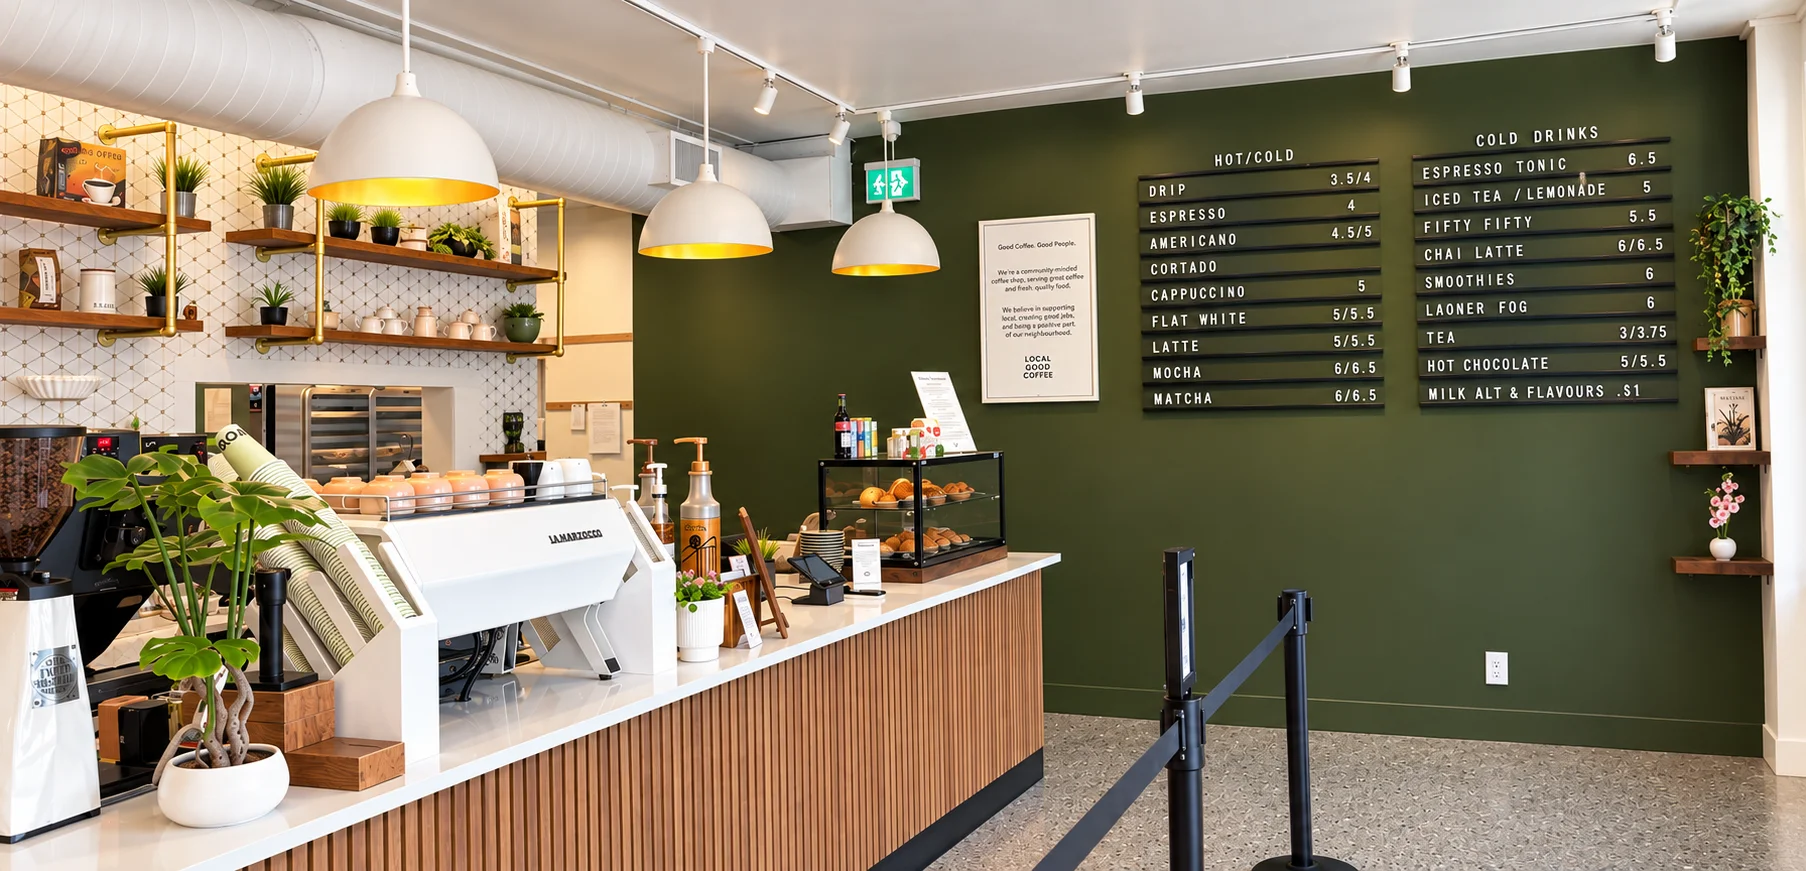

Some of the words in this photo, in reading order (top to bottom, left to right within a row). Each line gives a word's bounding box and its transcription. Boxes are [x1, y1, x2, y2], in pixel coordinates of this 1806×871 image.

[1476, 131, 1518, 148] COLD
[1534, 125, 1598, 144] DRINKS
[1214, 148, 1294, 167] HOT/COLD
[1628, 151, 1656, 166] 6.5
[1422, 161, 1502, 180] ESPRESSO
[1515, 157, 1566, 173] TONIC
[1330, 171, 1371, 186] 3.5/4
[1149, 183, 1186, 198] DRIP
[1643, 180, 1651, 194] 5
[1347, 199, 1356, 212] 4
[1424, 192, 1461, 207] ICED
[1472, 189, 1502, 204] TEA
[1149, 207, 1226, 224] ESPRESSO
[1629, 208, 1657, 223] 5.5
[1331, 225, 1372, 239] 4.5/5
[1424, 218, 1471, 234] FIFTY
[1484, 215, 1532, 231] FIFTY
[997, 243, 1014, 251] Good
[1054, 240, 1076, 248] People.
[1149, 233, 1237, 250] AMERICANO
[1618, 237, 1663, 252] 6/6.5
[1424, 247, 1461, 262] CHAI
[1475, 244, 1524, 259] LATTE
[1150, 260, 1217, 276] CORTADO
[1645, 266, 1654, 280] 6
[1027, 275, 1048, 283] serving
[1358, 279, 1366, 293] 5
[1425, 272, 1515, 289] SMOOTHIES
[1151, 285, 1245, 302] CAPPUCCINO
[1042, 304, 1075, 313] supporting
[1425, 301, 1485, 317] LAONER
[1499, 300, 1527, 314] FOG
[1646, 295, 1655, 309] 6
[1043, 313, 1060, 321] good
[1152, 314, 1188, 328] FLAT
[1198, 311, 1246, 326] WHITE
[1333, 306, 1375, 321] 5/5.5
[1426, 330, 1455, 345] TEA
[1619, 325, 1667, 340] 3/3.75
[1152, 339, 1199, 354] LATTE
[1333, 333, 1375, 348] 5/5.5
[1024, 355, 1051, 363] LOCAL
[1427, 359, 1455, 373] HOT
[1463, 356, 1549, 372] CHOCOLATE
[1620, 354, 1666, 368] 5/5.5
[1025, 363, 1051, 371] GOOD
[1153, 365, 1202, 379] MOCHA
[1334, 361, 1376, 375] 6/6.5
[1023, 371, 1053, 379] COFFEE
[1153, 392, 1212, 406] MATCHA
[1335, 388, 1377, 403] 6/6.5
[1428, 387, 1466, 401] MILK
[1475, 386, 1502, 400] ALT
[1509, 386, 1519, 399] &
[1527, 384, 1604, 399] FLAVOURS
